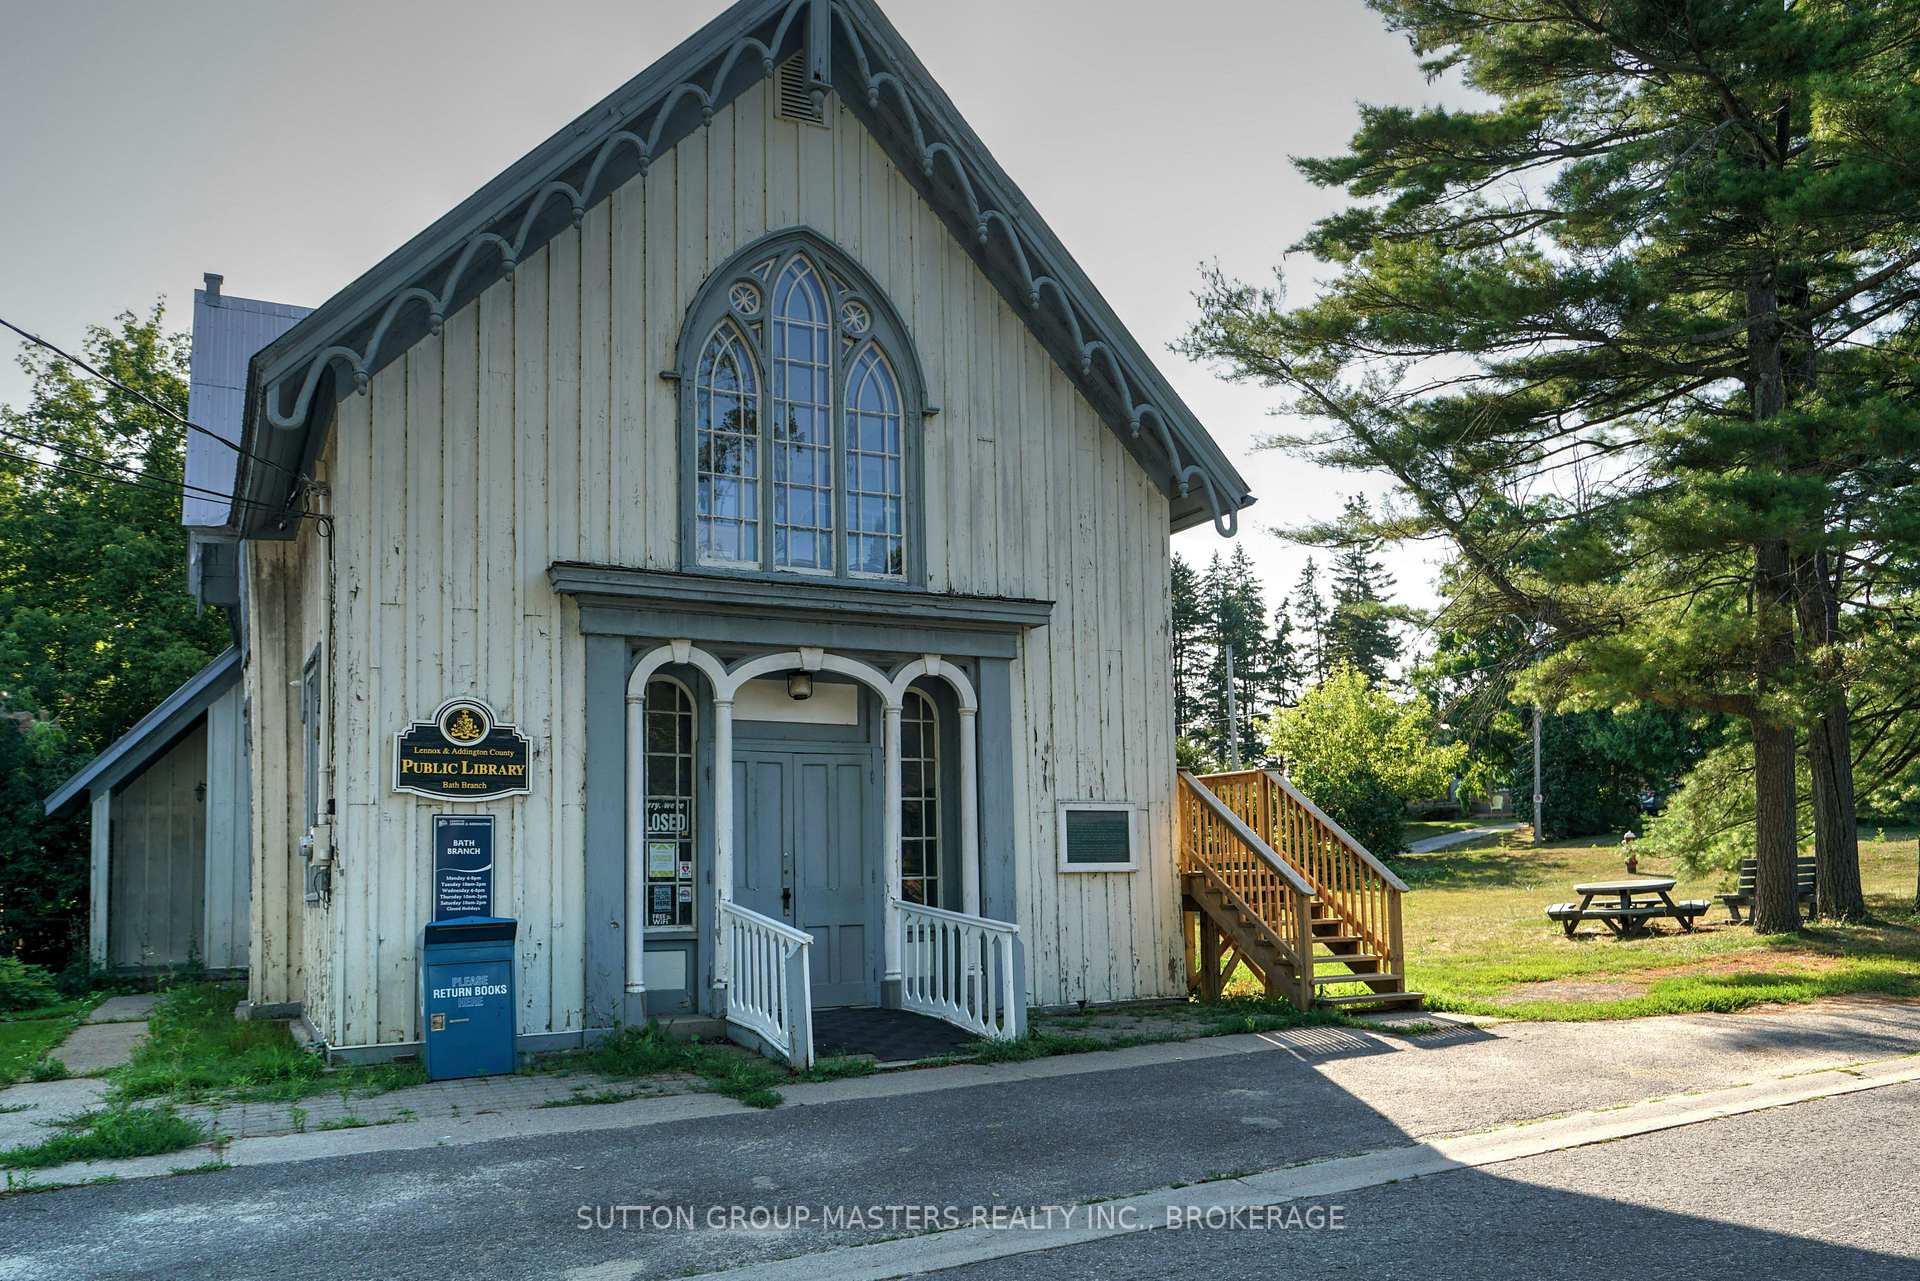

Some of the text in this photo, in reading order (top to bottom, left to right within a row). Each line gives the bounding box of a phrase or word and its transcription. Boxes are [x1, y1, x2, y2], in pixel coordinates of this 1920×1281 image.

[414, 746, 515, 757] Lennox & Addington County
[401, 758, 525, 776] PUBLIC LIBRARY
[442, 781, 487, 789] Bath Branch
[647, 813, 686, 831] LOSED
[453, 839, 475, 847] BATH
[447, 847, 481, 855] BRANCH
[451, 975, 489, 987] PLEASE
[433, 984, 508, 999] RETURN BOOKS
[457, 997, 484, 1008] HERE
